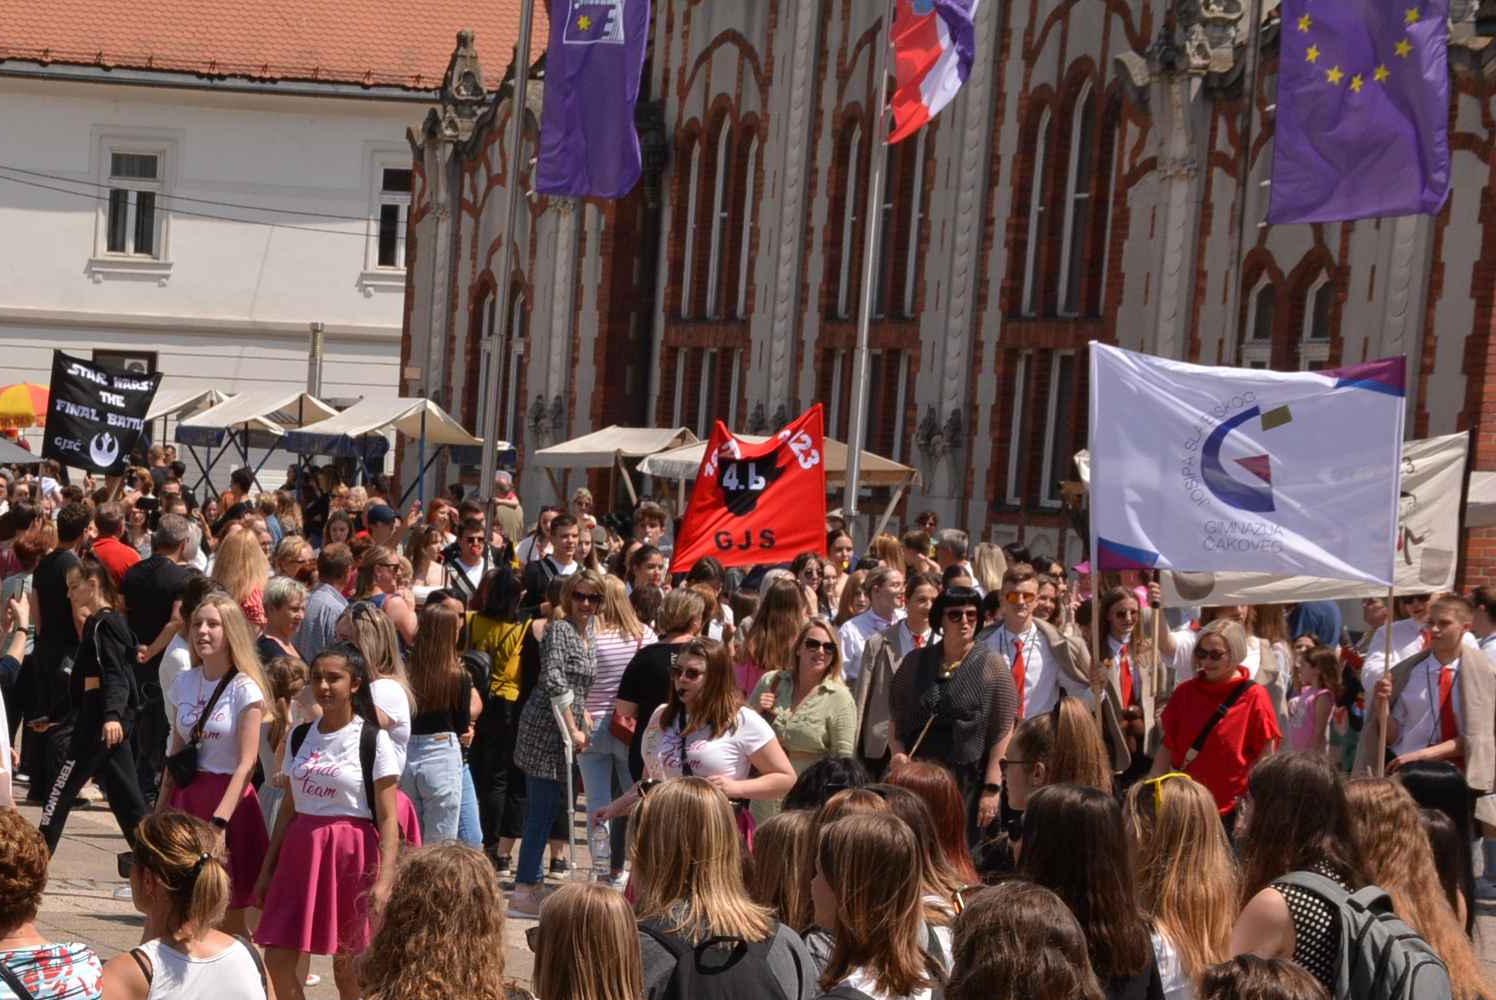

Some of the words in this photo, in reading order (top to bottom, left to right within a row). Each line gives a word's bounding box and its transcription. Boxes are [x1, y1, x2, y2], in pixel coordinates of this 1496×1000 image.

[67, 363, 108, 387] STAR
[55, 399, 100, 421] FINAL
[99, 391, 126, 408] THE
[714, 528, 776, 550] GJS
[300, 776, 338, 798] team
